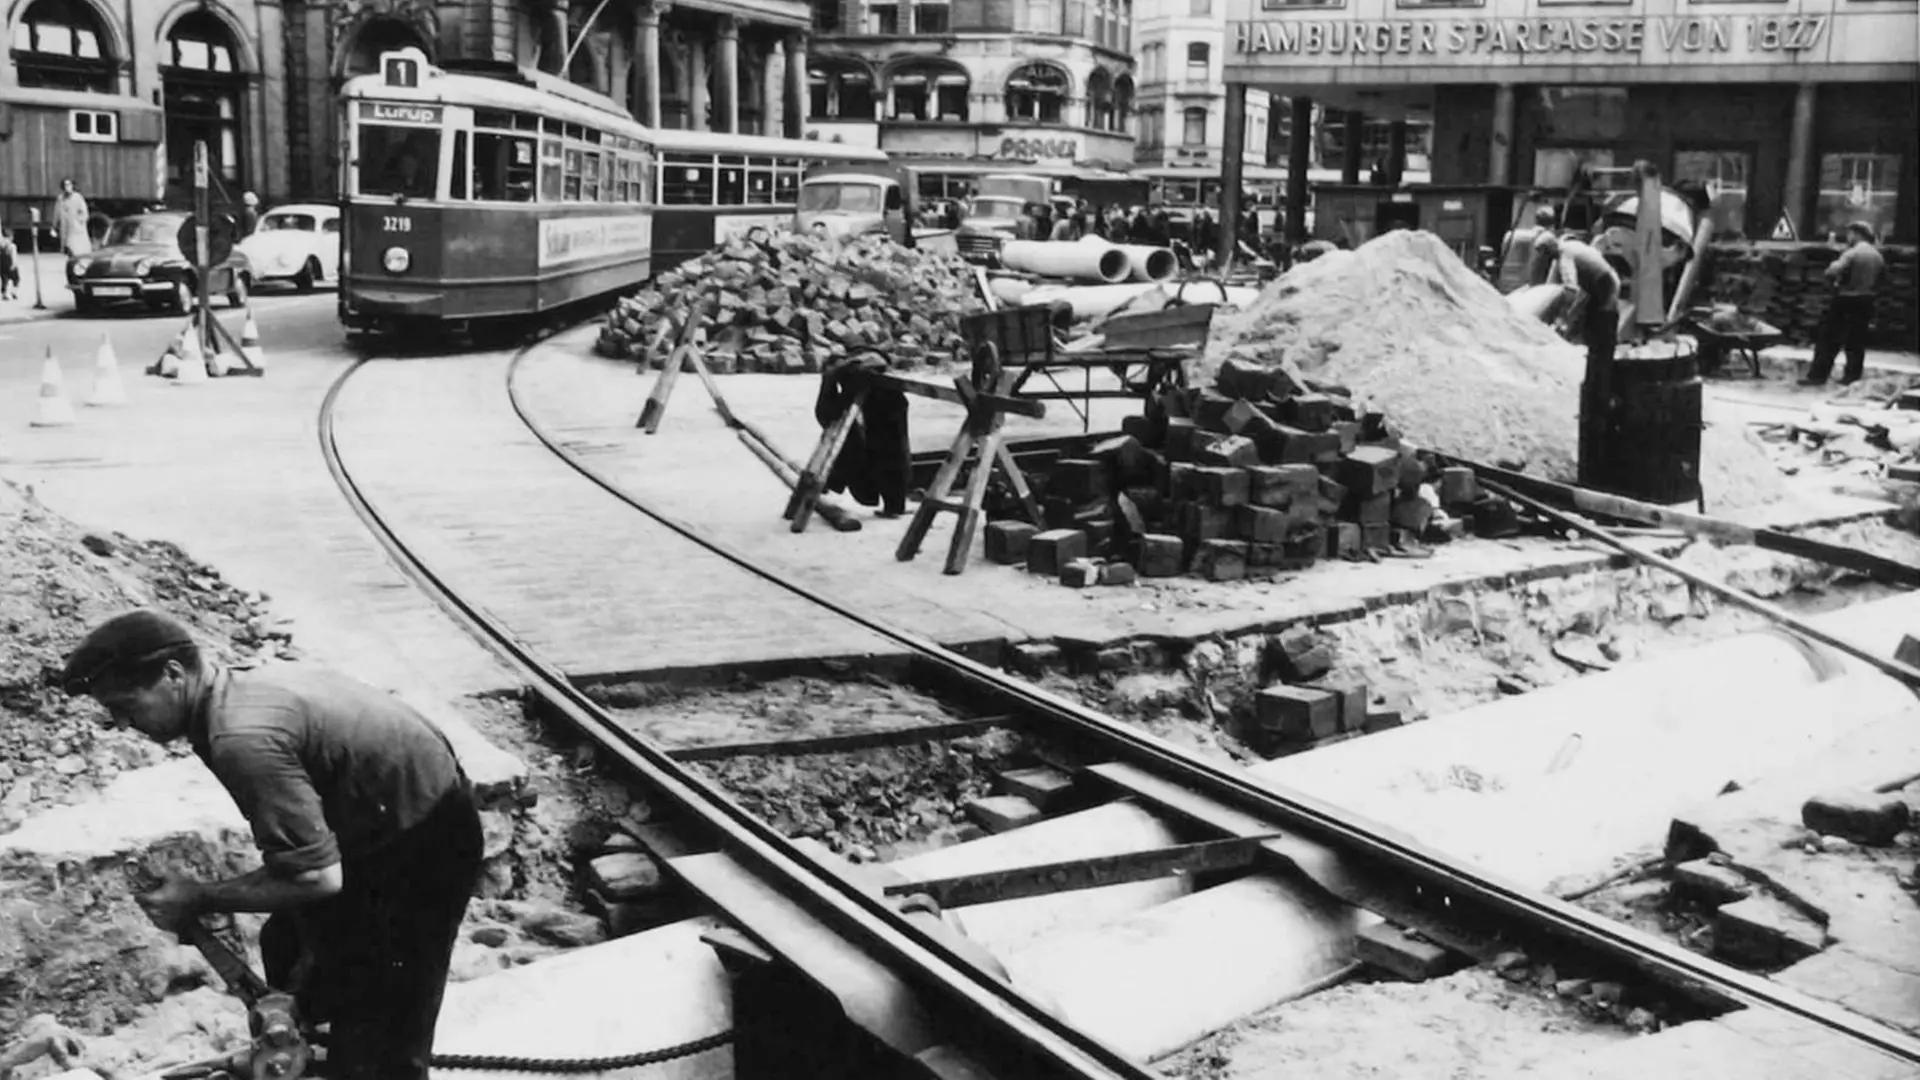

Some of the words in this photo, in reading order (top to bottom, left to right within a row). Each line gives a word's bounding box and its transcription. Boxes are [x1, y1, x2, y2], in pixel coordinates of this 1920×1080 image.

[1235, 20, 1436, 53] HAMBURGER
[1448, 19, 1643, 52] SPARCASSE
[1658, 17, 1731, 51] VON
[1746, 16, 1827, 51] 1827
[396, 61, 406, 85] 1
[374, 104, 434, 124] Lurup
[383, 215, 412, 231] 3219
